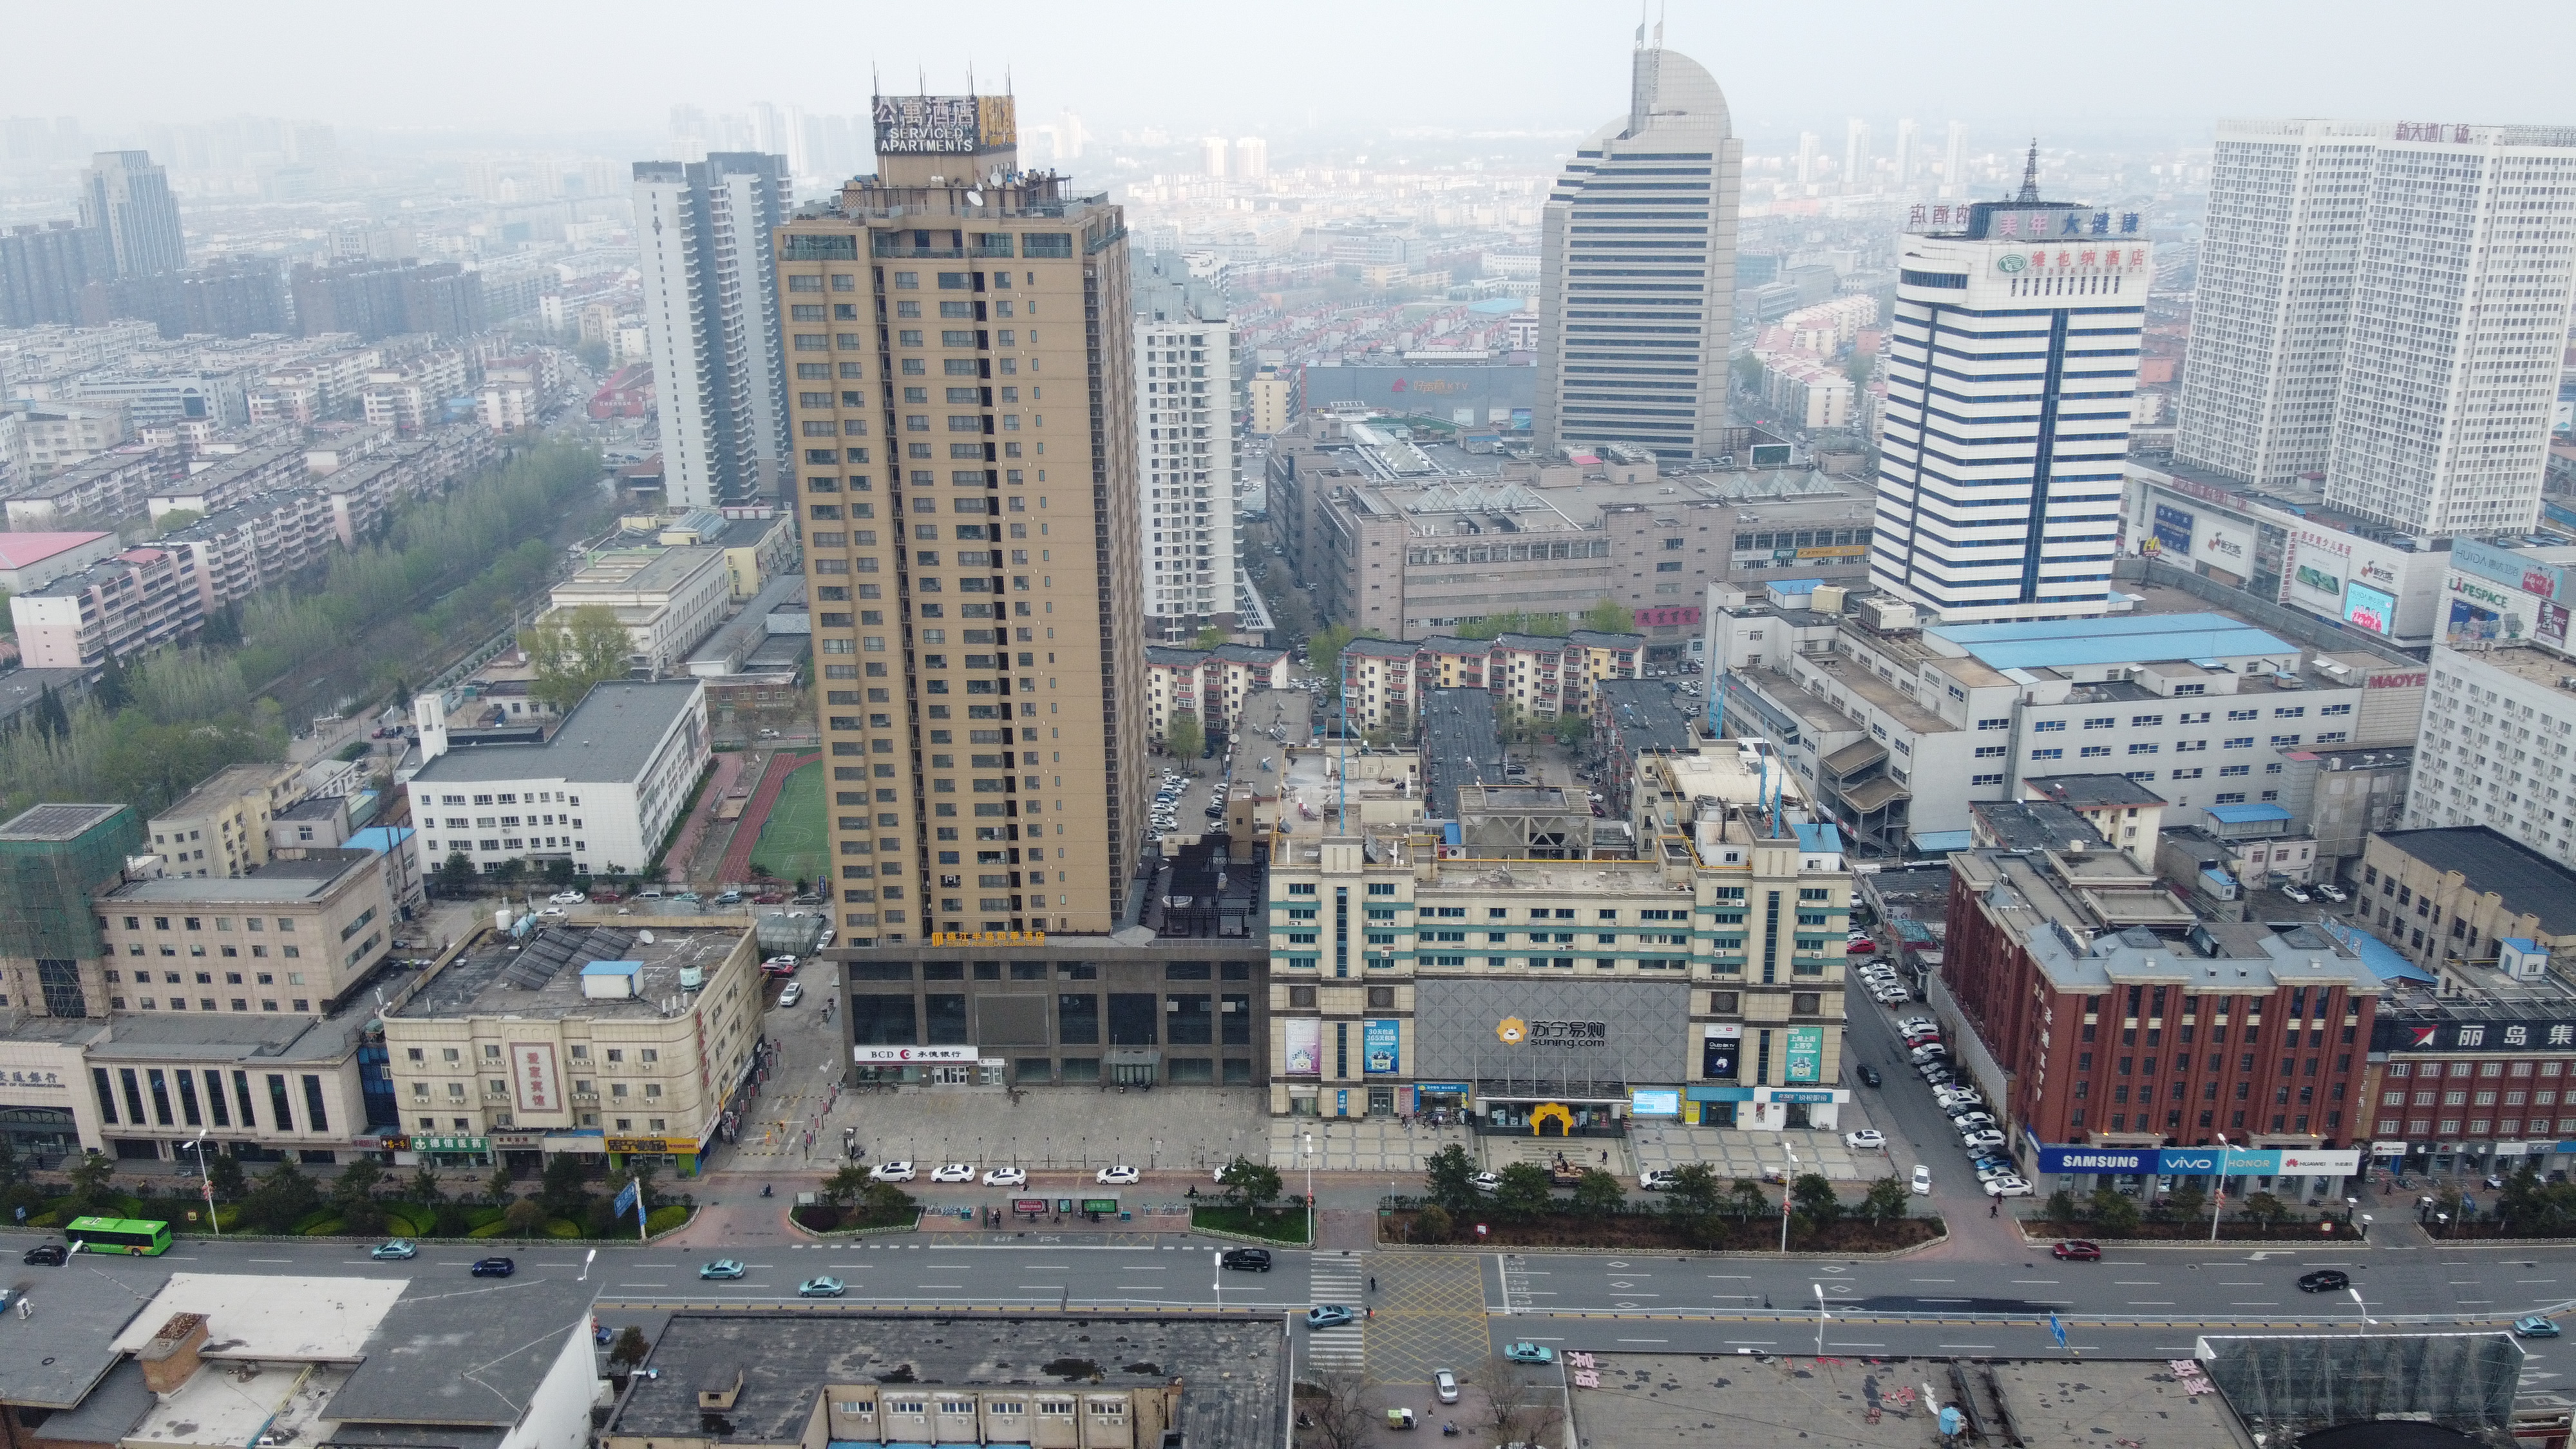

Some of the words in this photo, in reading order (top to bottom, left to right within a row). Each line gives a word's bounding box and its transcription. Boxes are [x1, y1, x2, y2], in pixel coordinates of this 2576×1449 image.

[875, 97, 976, 126] 公寓酒店
[890, 128, 963, 139] SERVICED
[2395, 120, 2470, 144] 新天地广场
[880, 140, 974, 152] APARTMENTS
[2000, 212, 2139, 236] 美年大健康
[2031, 249, 2145, 267] 维也纳酒店
[2455, 549, 2487, 567] HUIDA
[2553, 616, 2566, 625] KFC
[2368, 672, 2427, 689] MAOYE
[947, 931, 1045, 941] 锦江半岛四季酒店
[1531, 1020, 1605, 1037] 苏宁易购
[2458, 1024, 2575, 1046] 丽岛集
[1531, 1037, 1605, 1049] suning.com
[429, 1139, 482, 1148] 德信医药
[2062, 1155, 2139, 1168] SAMSUNG
[2227, 1159, 2271, 1168] HONOR
